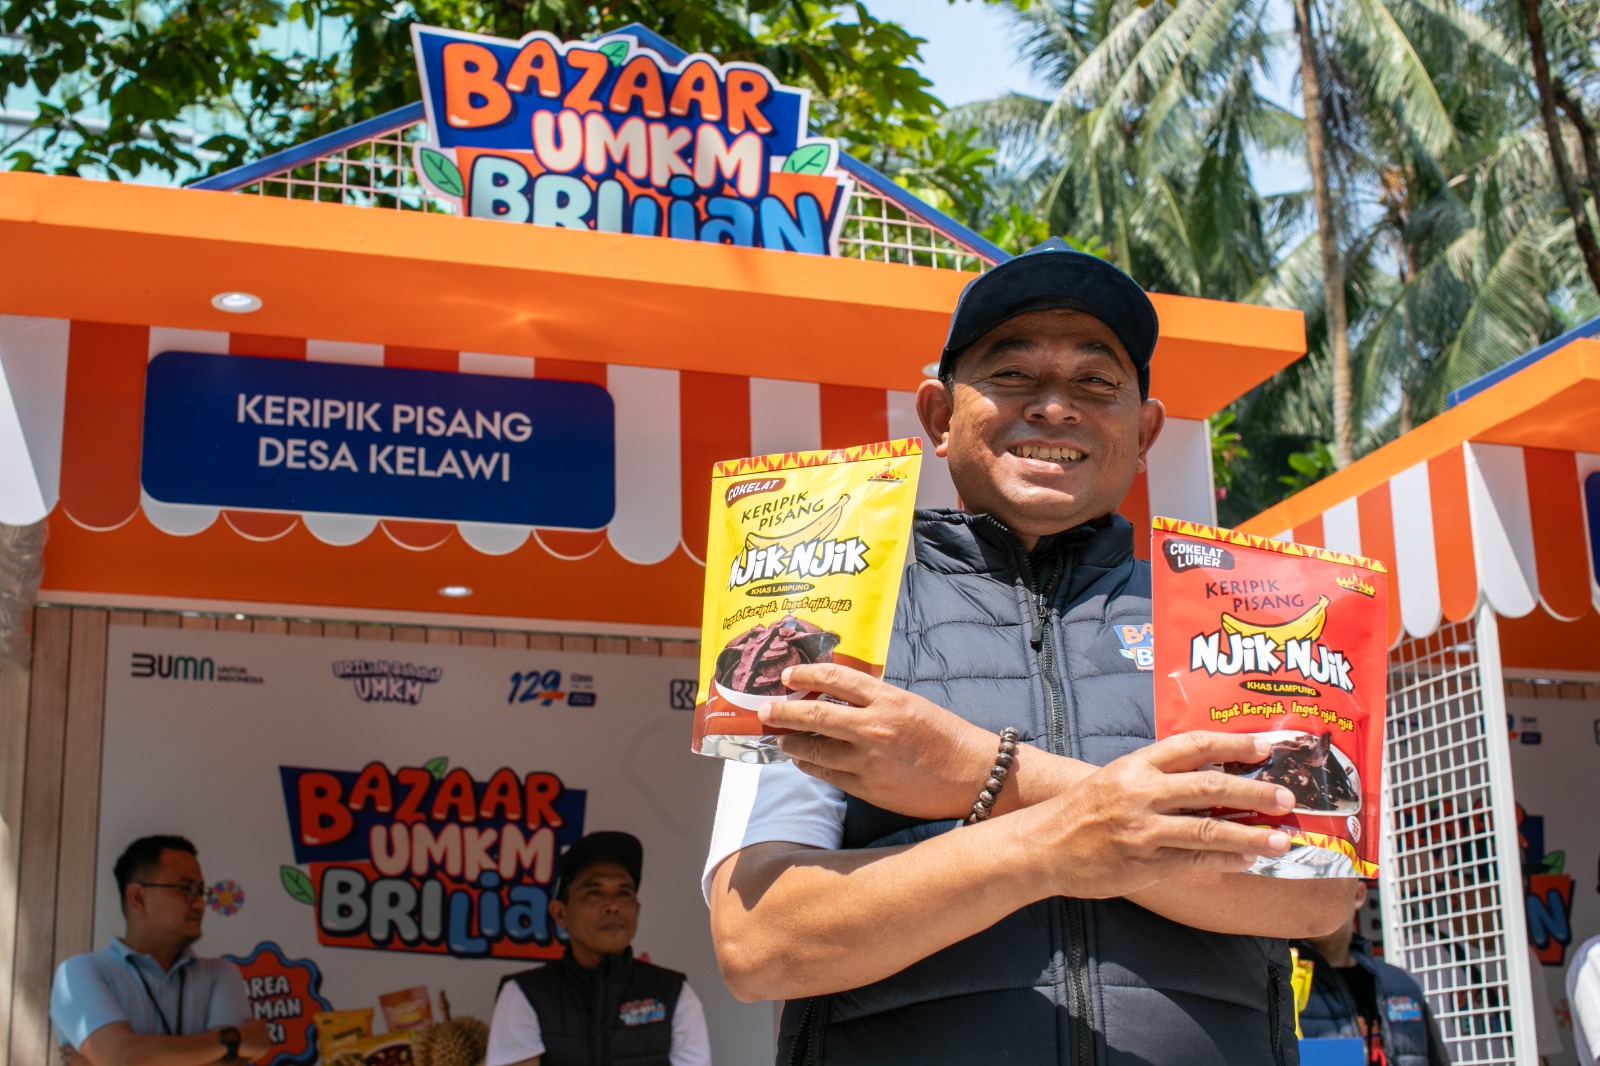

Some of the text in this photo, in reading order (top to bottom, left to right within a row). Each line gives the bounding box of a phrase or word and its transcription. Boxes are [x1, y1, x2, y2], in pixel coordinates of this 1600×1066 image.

[442, 39, 773, 134] BAZAAR
[533, 110, 762, 197] UMKM
[237, 394, 533, 442] KERIPIK PISANG
[258, 437, 510, 482] DESA KELAWI
[727, 480, 780, 501] COKELAT
[741, 491, 808, 524] KERIPIK
[759, 499, 824, 531] PISANG
[1169, 543, 1224, 559] COKELAT
[1177, 554, 1221, 568] LUMER
[751, 583, 810, 596] KHAS LAMPUNG
[781, 596, 810, 614] Inget
[809, 596, 830, 612] njik
[829, 600, 852, 614] njik
[1205, 580, 1280, 599] KERIPIK
[1233, 594, 1304, 613] PISANG
[355, 678, 423, 703] UMKM
[508, 669, 562, 706] 129
[1247, 682, 1317, 696] KHAS LAMPUNG
[1210, 703, 1241, 723] Ingat
[1291, 701, 1319, 718] Inget
[1320, 709, 1337, 724] njik
[1337, 717, 1354, 731] njik
[297, 760, 564, 846] BAZAAR
[369, 822, 555, 884] UMKM
[319, 867, 568, 954] BRILia
